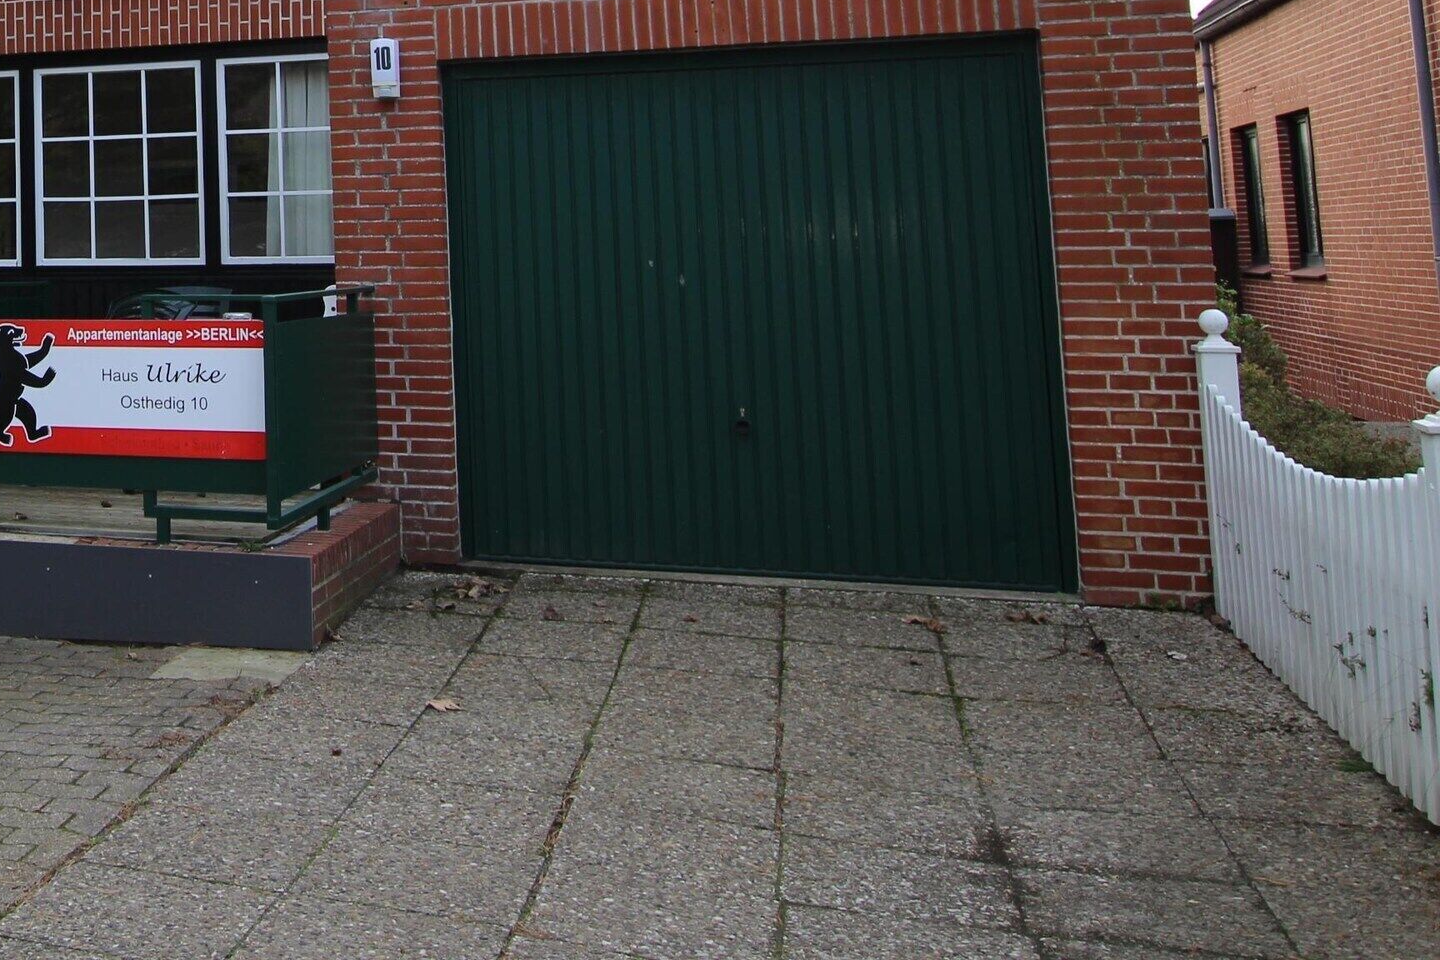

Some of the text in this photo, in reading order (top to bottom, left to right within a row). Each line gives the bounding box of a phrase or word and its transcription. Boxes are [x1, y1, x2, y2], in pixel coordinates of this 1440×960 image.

[374, 46, 391, 71] 10
[67, 327, 183, 343] Appartementanlage
[101, 362, 226, 384] Haus Ulrike
[120, 395, 208, 413] Osthedig 10
